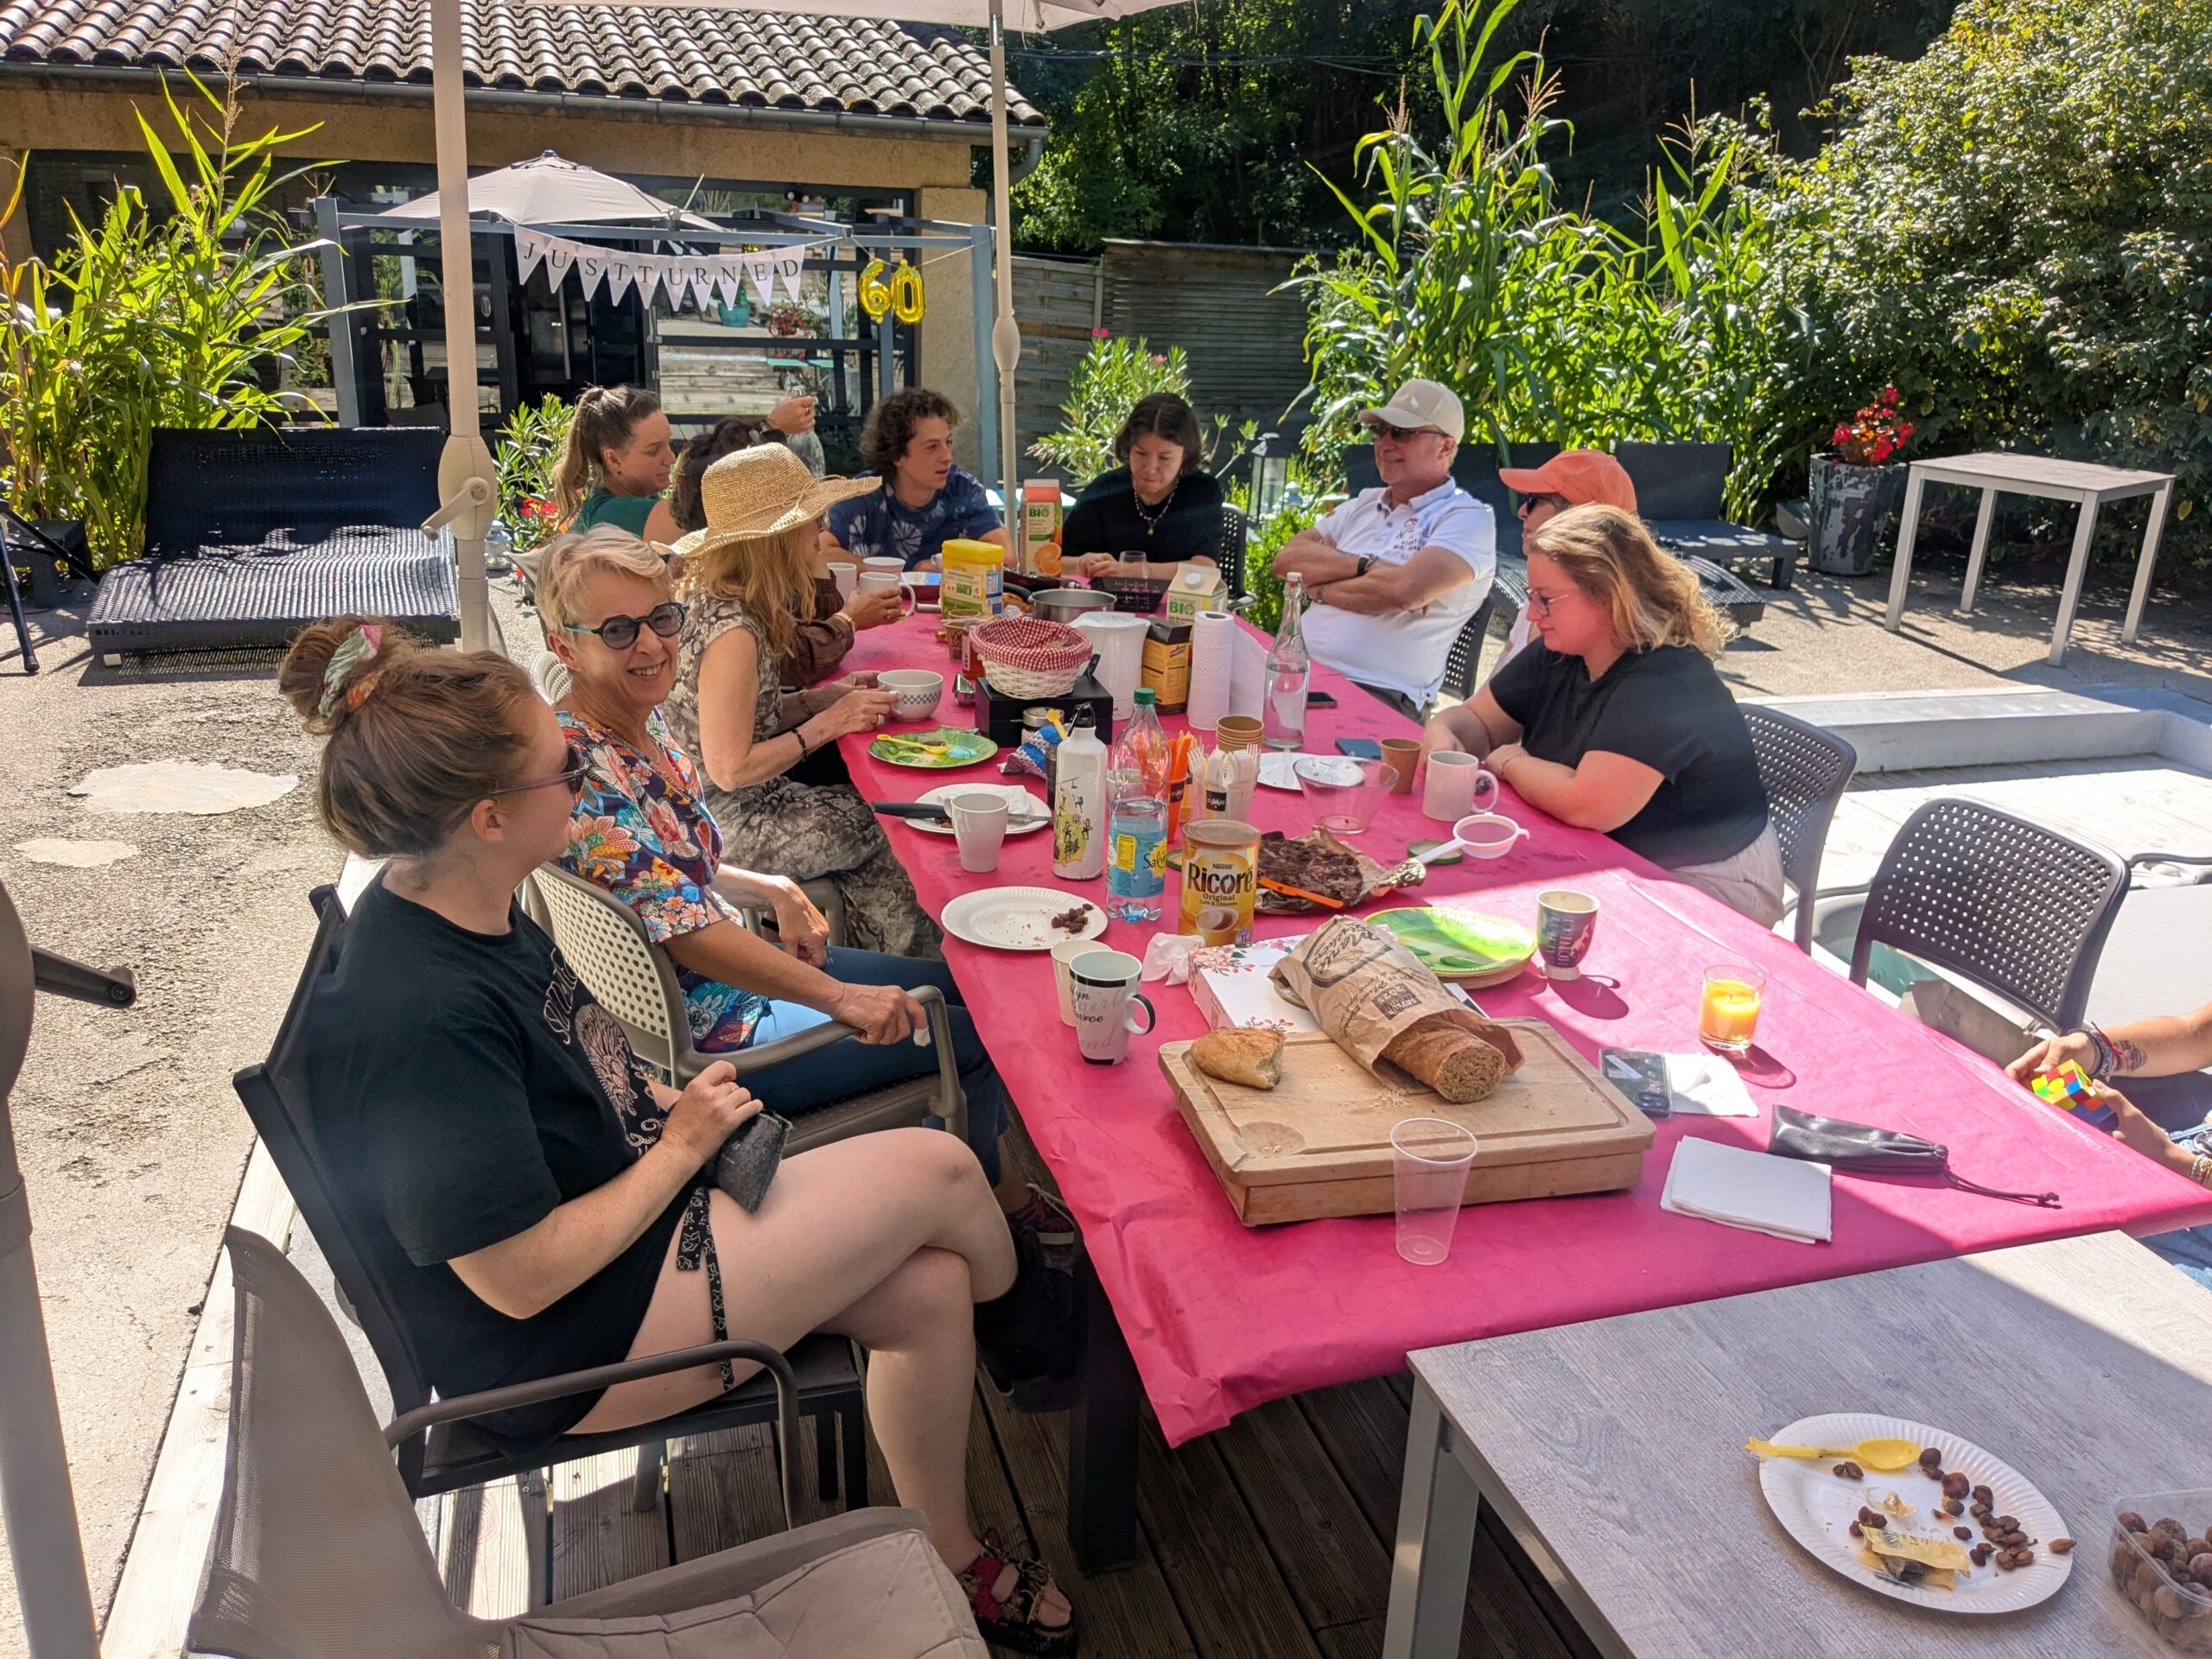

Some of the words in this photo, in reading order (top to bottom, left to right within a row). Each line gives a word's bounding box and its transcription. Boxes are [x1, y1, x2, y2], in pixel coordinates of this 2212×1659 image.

[858, 257, 926, 325] 60
[1028, 508, 1050, 518] BIO
[1169, 601, 1196, 616] BIO
[1187, 861, 1253, 894] Ricoré
[1202, 893, 1236, 901] Original
[1376, 984, 1405, 1004] 2025
